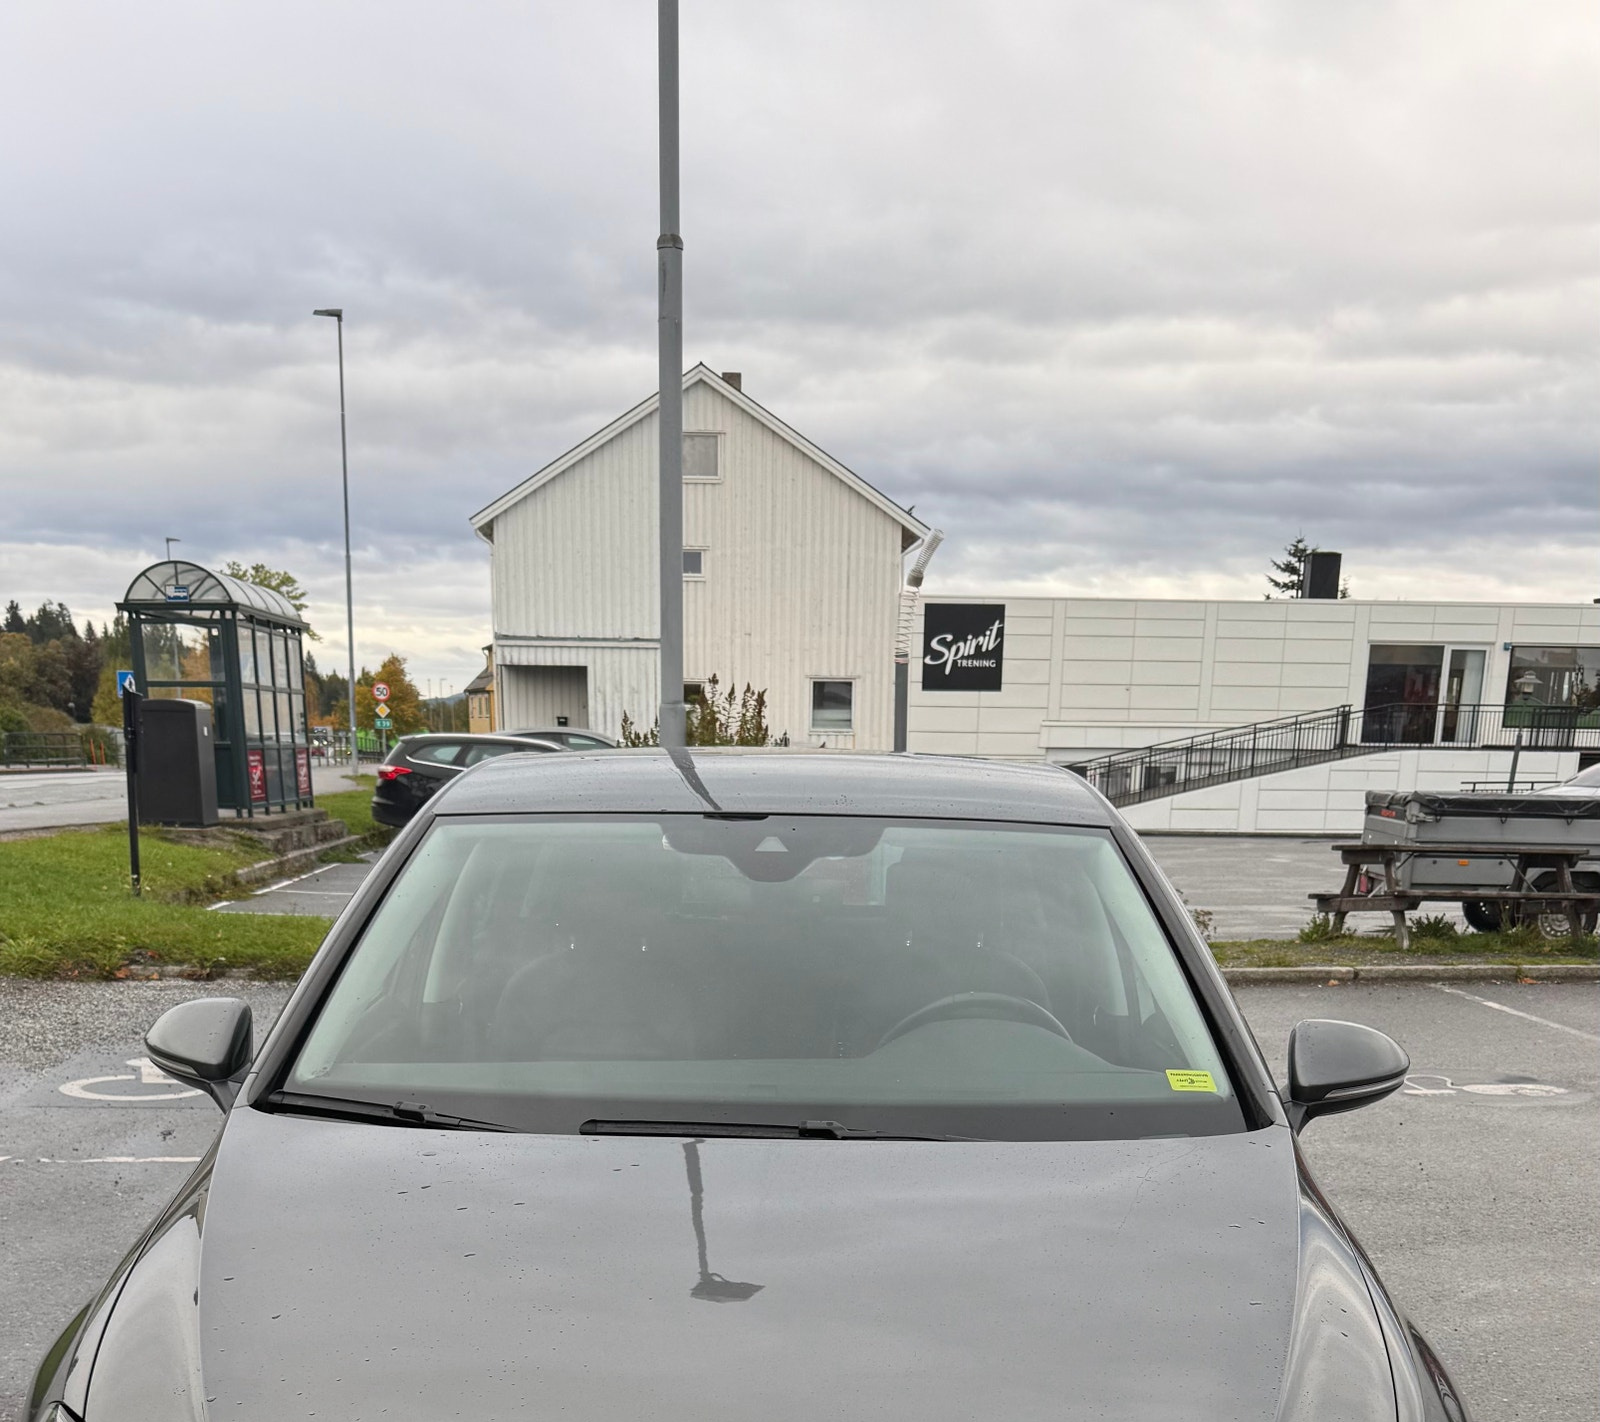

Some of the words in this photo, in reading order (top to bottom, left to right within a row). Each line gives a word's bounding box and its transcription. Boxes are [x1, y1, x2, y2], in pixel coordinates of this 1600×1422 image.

[924, 619, 1003, 675] Spirit
[957, 659, 996, 668] TRENING
[376, 687, 388, 697] 50
